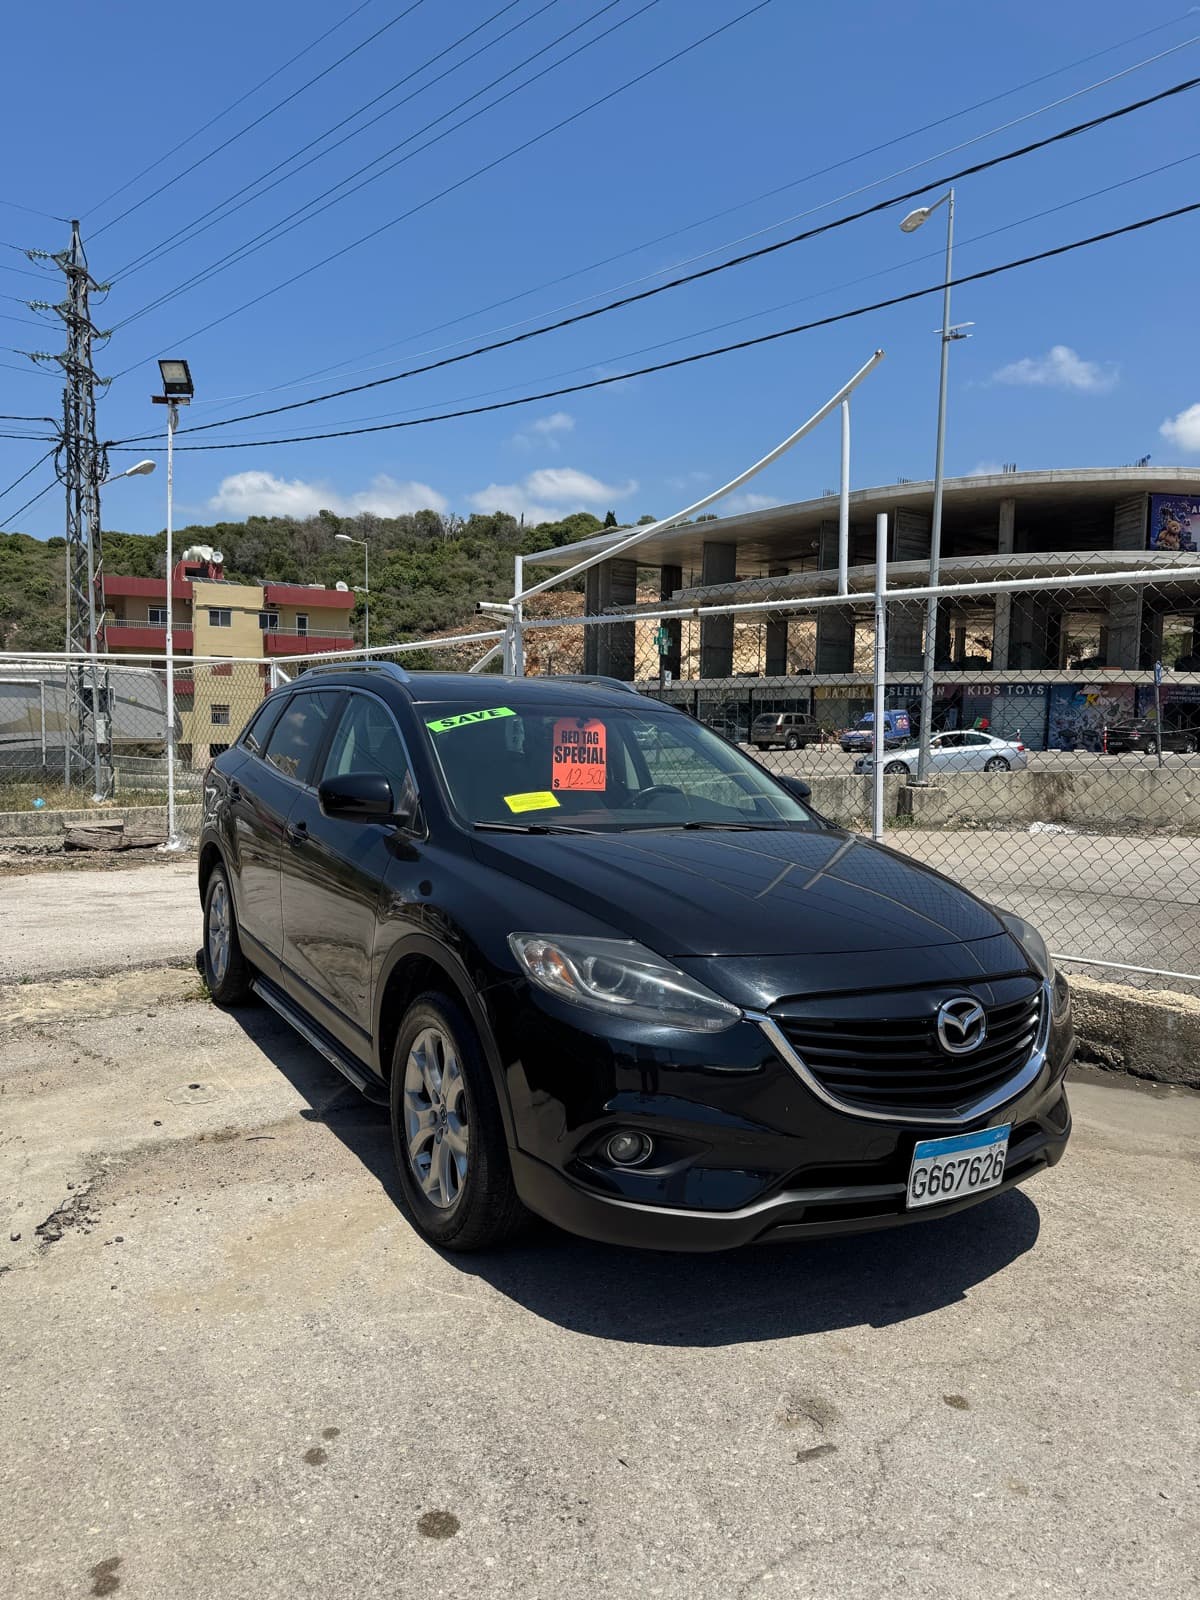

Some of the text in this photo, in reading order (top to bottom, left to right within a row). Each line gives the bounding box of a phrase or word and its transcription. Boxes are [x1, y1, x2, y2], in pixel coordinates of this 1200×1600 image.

[889, 686, 945, 696] SLEIMN
[967, 684, 1045, 696] KIDS TOYS
[440, 710, 502, 727] SAVE
[561, 730, 599, 745] RED TAG
[554, 746, 605, 765] SPECIAL
[912, 1150, 1005, 1199] G667626
